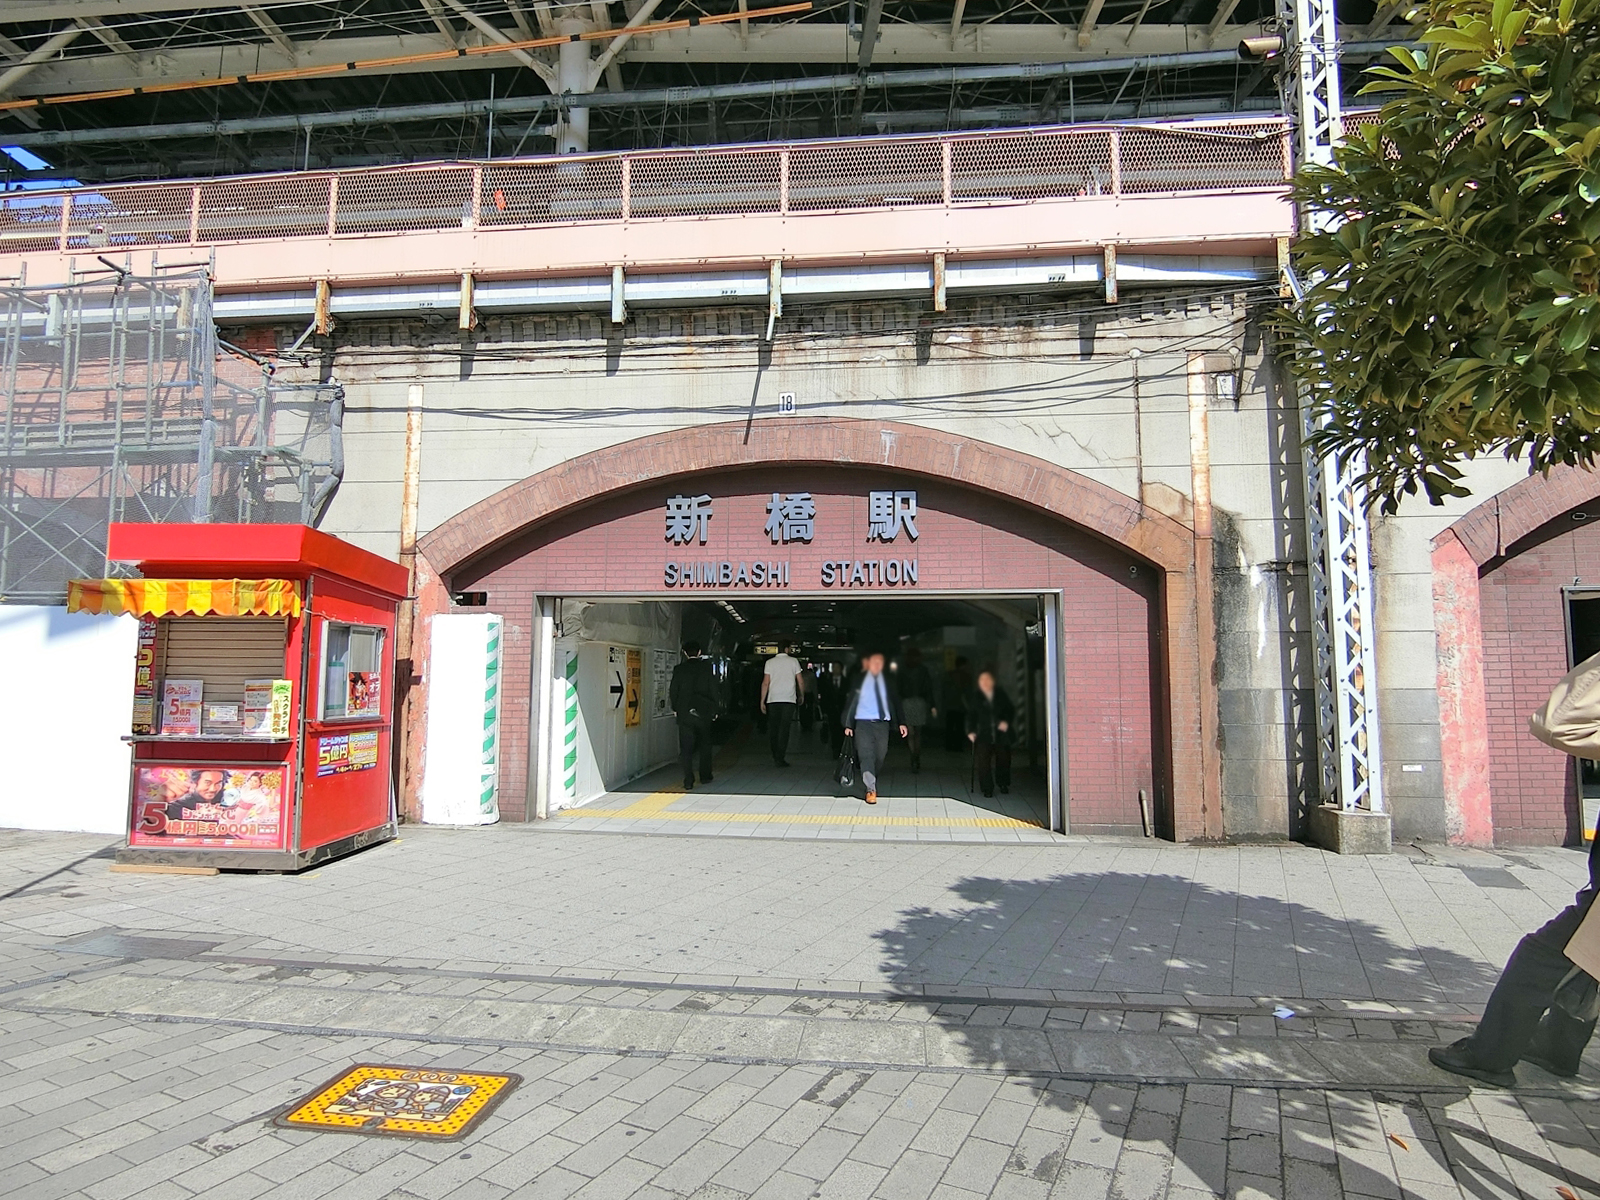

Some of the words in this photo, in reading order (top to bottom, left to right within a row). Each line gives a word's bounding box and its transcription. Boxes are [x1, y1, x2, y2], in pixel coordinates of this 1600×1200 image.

[781, 395, 792, 411] 18
[665, 490, 919, 546] 新橋駅
[665, 560, 790, 587] SHIMBASHI
[821, 558, 918, 587] STATION
[280, 695, 290, 734] スクラッチ
